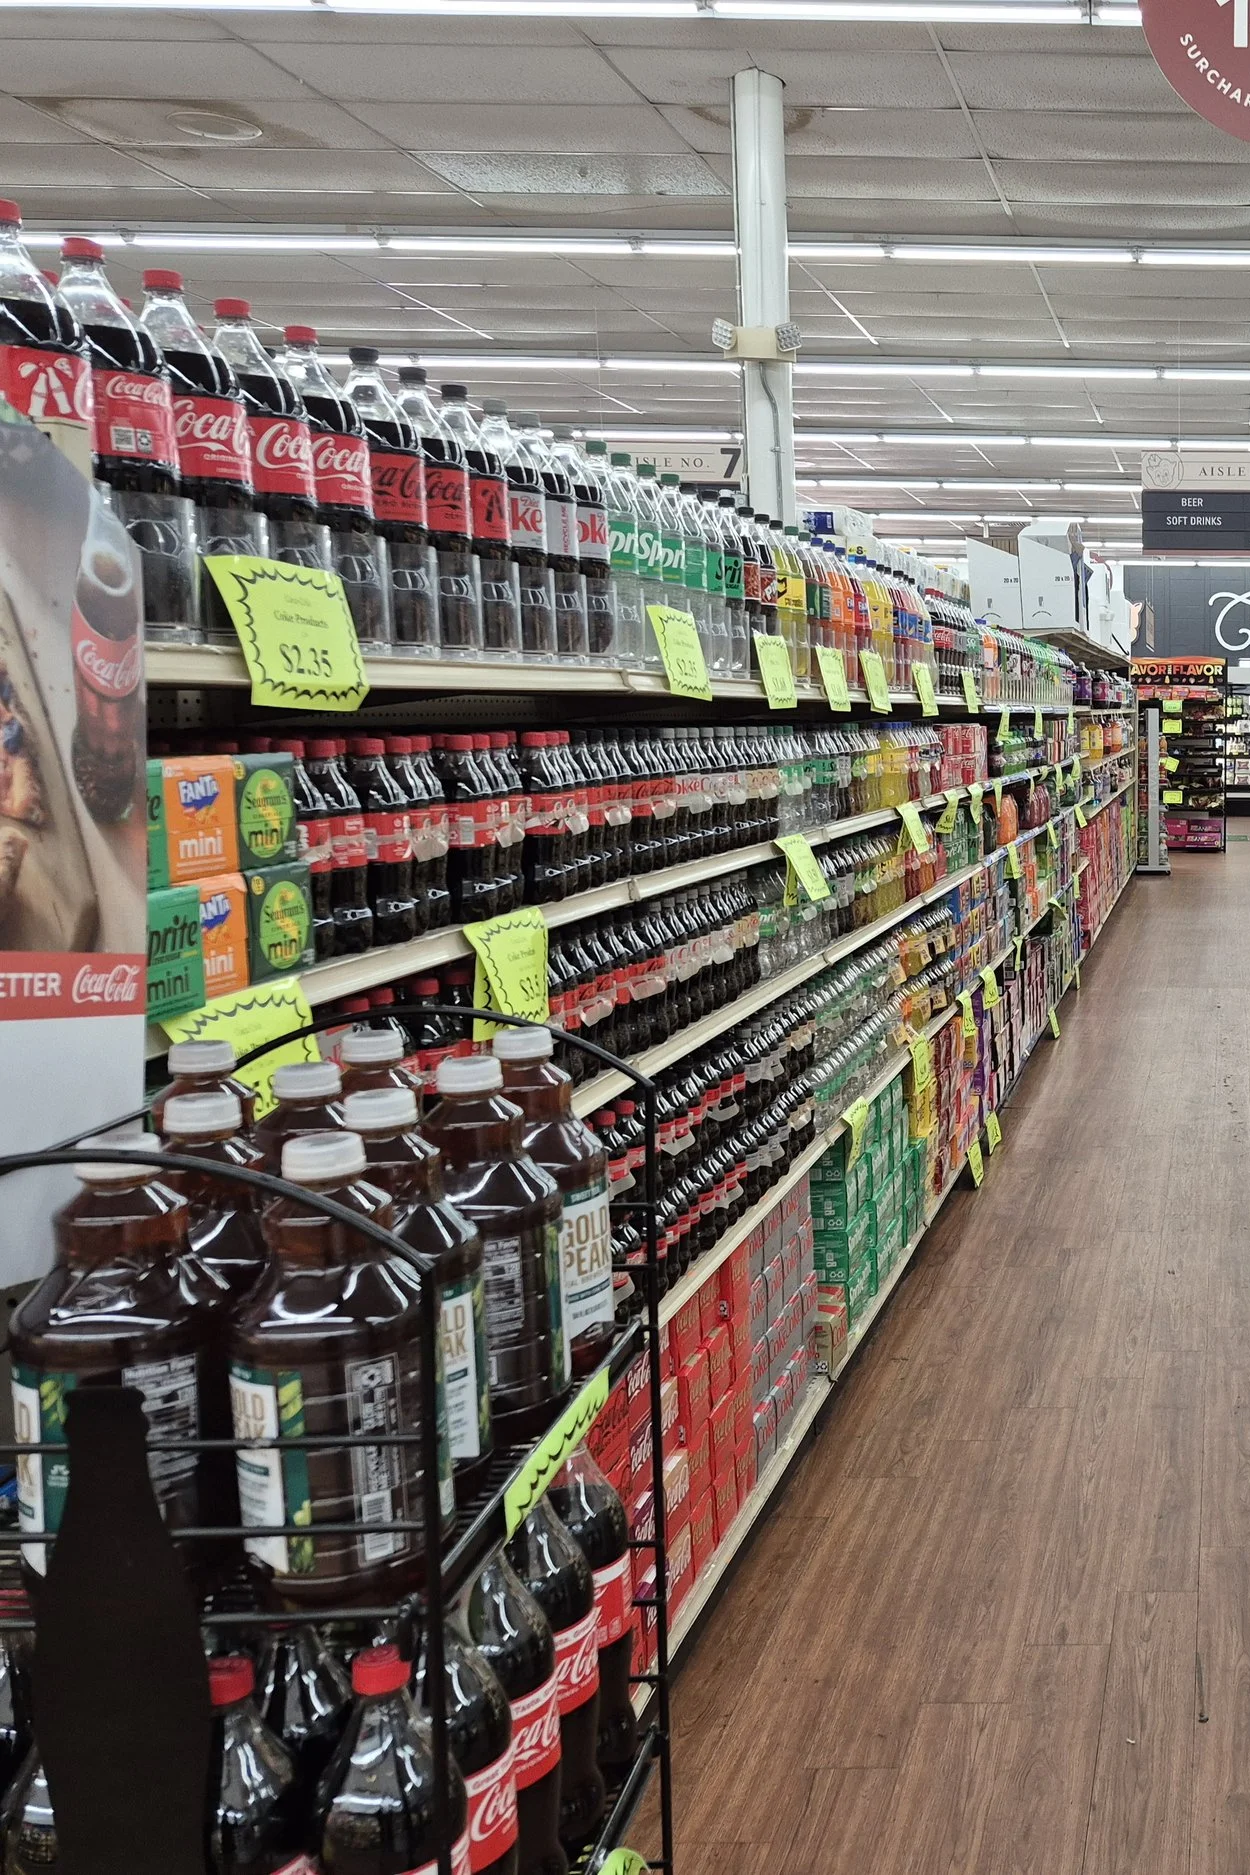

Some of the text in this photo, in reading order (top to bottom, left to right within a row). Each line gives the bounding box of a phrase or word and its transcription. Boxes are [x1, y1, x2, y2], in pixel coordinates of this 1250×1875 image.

[636, 448, 742, 478] ISLE NO. 7
[1198, 466, 1246, 477] AISLE
[1181, 498, 1204, 507] BEER
[1166, 516, 1222, 526] SOFT DRINKS
[279, 643, 333, 678] $2.35
[1131, 664, 1166, 676] AVOR
[1172, 664, 1223, 676] FLAVOR
[178, 775, 219, 804] FANTA
[179, 828, 223, 859] mini
[249, 821, 284, 848] mini
[200, 894, 231, 921] ANTA
[148, 915, 198, 966] prite
[268, 930, 303, 960] mini
[0, 972, 62, 998] ETTER
[563, 1205, 608, 1249] GOLD
[564, 1233, 610, 1277] PEAK
[441, 1304, 465, 1336] LD
[443, 1328, 466, 1358] AK
[234, 1389, 265, 1421] OLD
